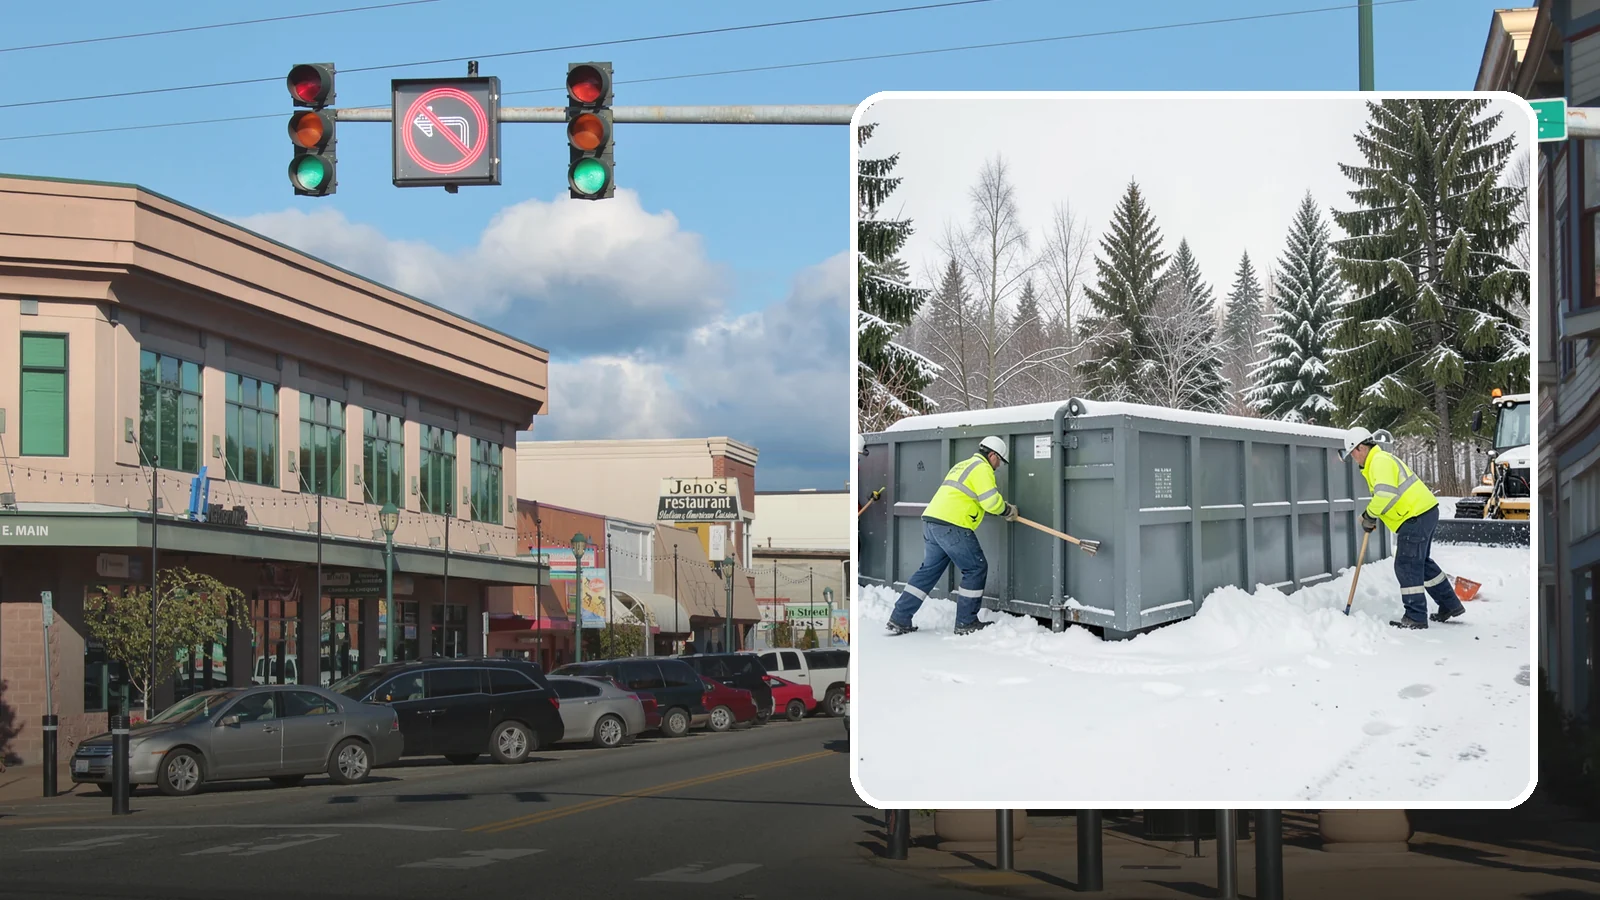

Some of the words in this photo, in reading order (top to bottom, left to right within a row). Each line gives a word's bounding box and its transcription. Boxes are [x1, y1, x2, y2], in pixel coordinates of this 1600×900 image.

[670, 480, 727, 494] Jeno's
[665, 496, 731, 509] restaurant
[658, 510, 682, 519] Italian
[686, 509, 714, 519] American
[714, 509, 737, 519] Cuisine
[2, 525, 13, 536] E.
[15, 525, 49, 536] MAIN
[797, 608, 829, 617] Street
[790, 619, 824, 627] lass
